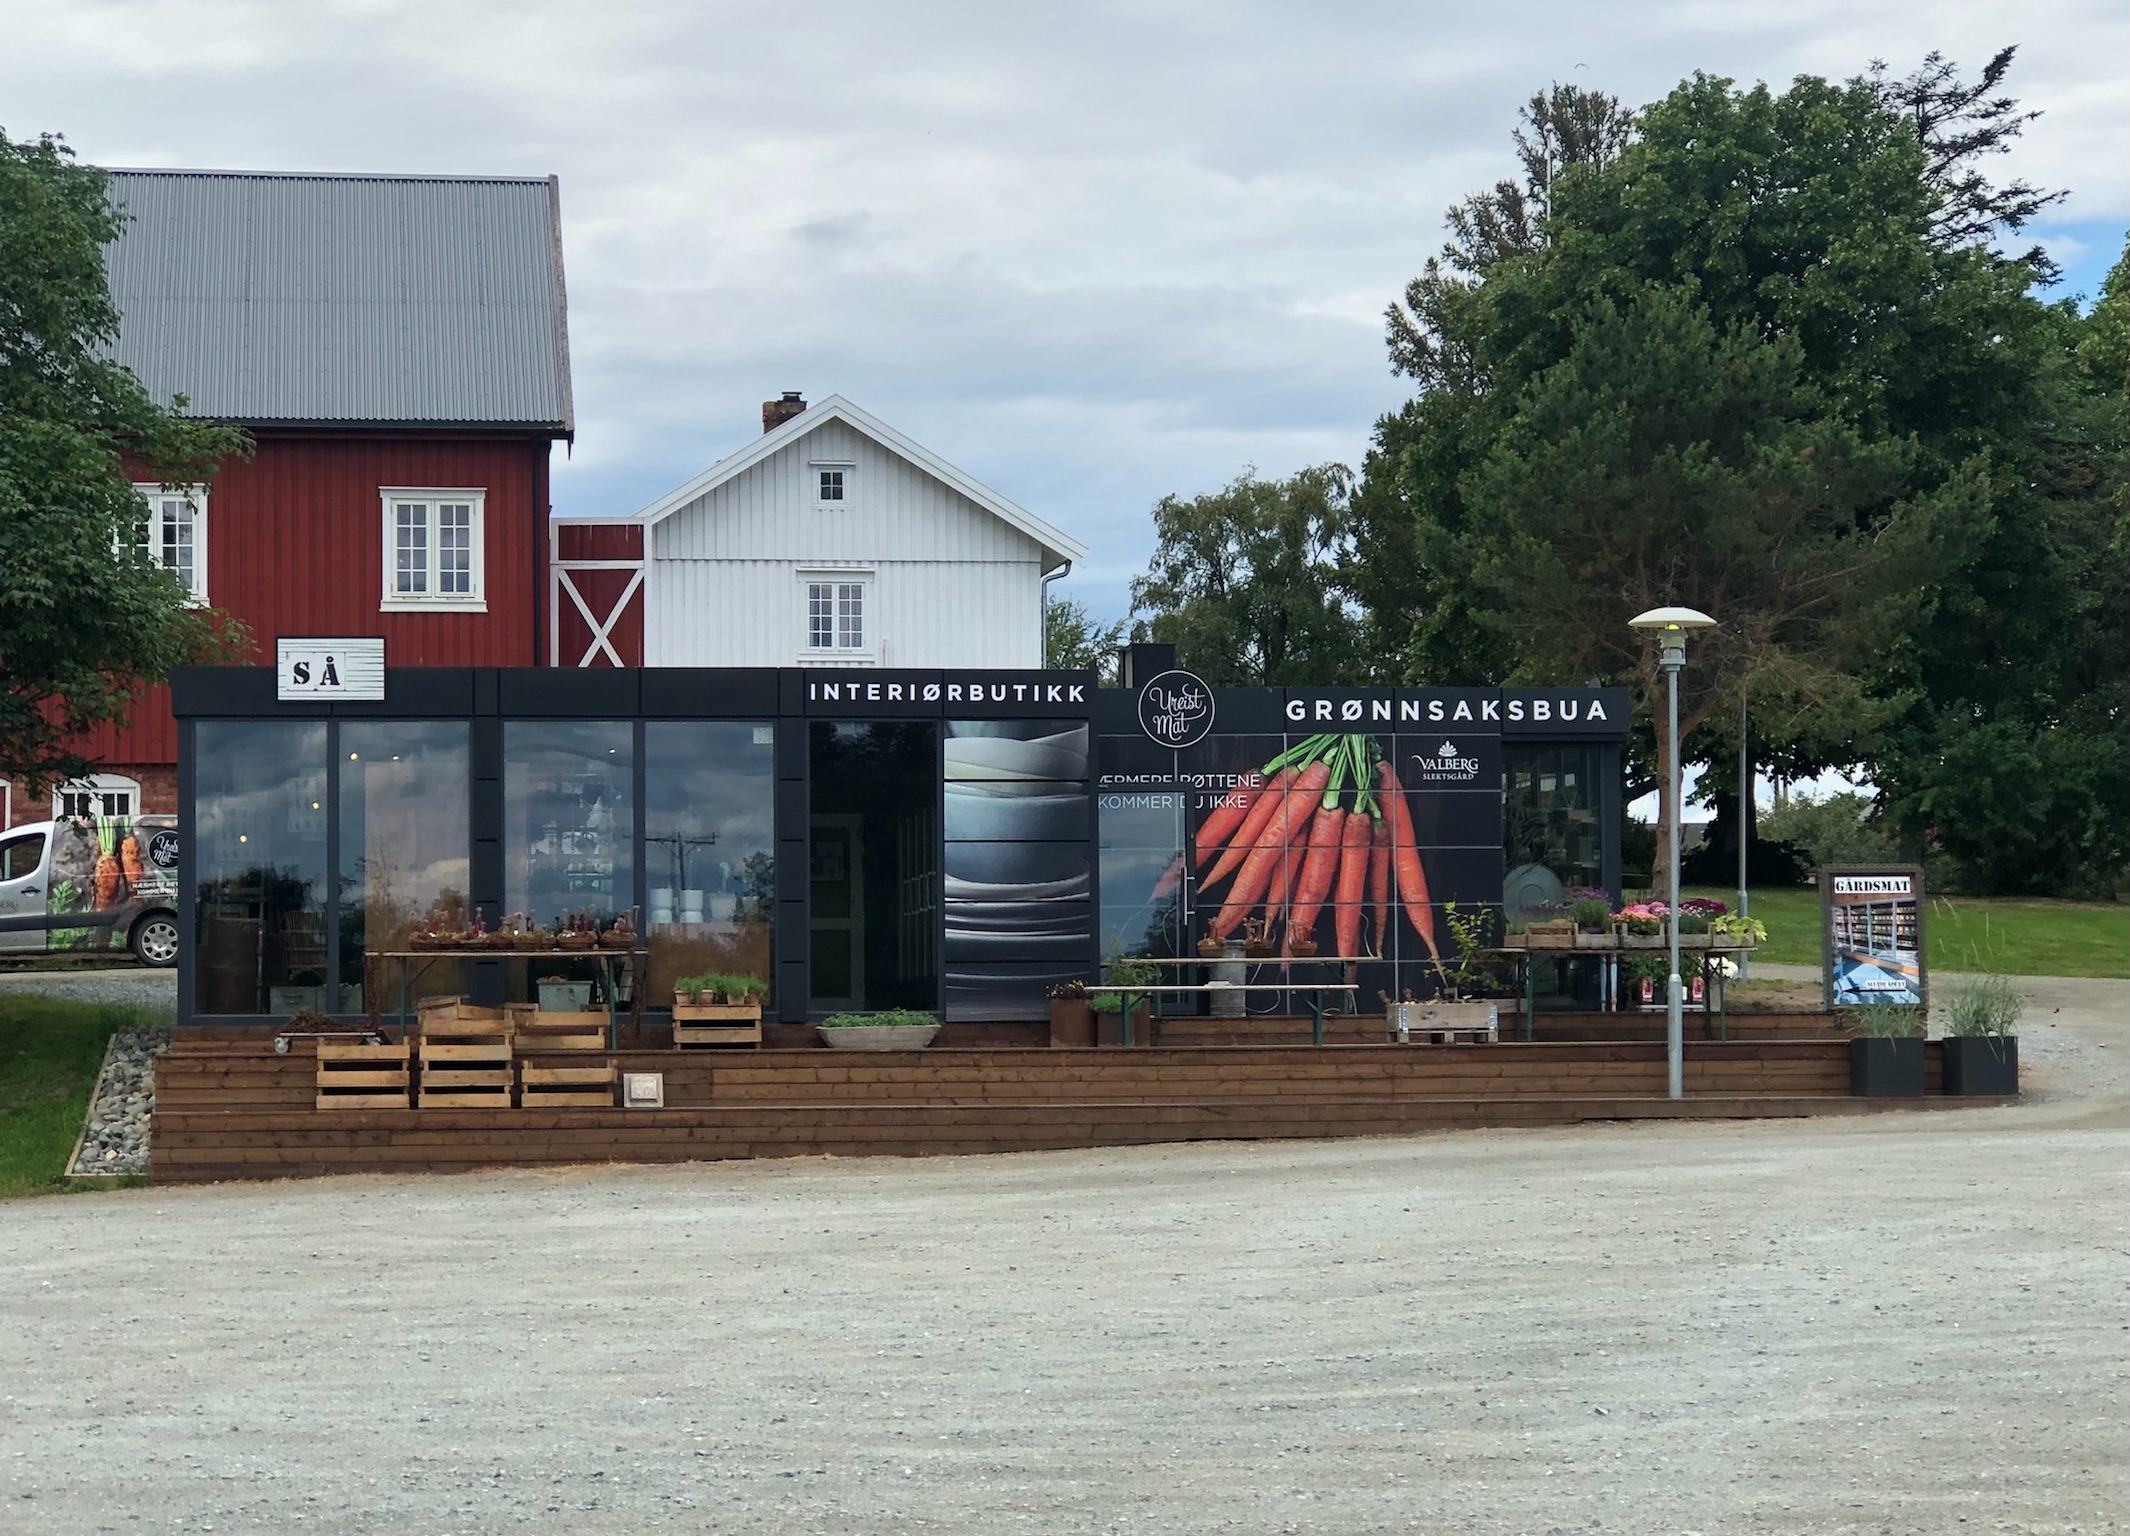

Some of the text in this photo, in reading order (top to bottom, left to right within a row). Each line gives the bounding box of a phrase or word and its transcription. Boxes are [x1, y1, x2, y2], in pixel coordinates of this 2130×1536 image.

[810, 683, 1085, 703] INTERIØRBUTIKK
[1149, 683, 1206, 717] Ureist
[1285, 699, 1608, 721] GRØNNSAKSBUA
[1152, 706, 1206, 741] Mat
[1411, 755, 1479, 774] VALBERG
[1099, 774, 1173, 783] ÆRMERE
[1423, 772, 1475, 780] SLEKTSGÅRD
[1098, 796, 1172, 809] KOMMER
[1210, 795, 1248, 809] IKKE
[1835, 878, 1910, 892] GÅRDSMAT
